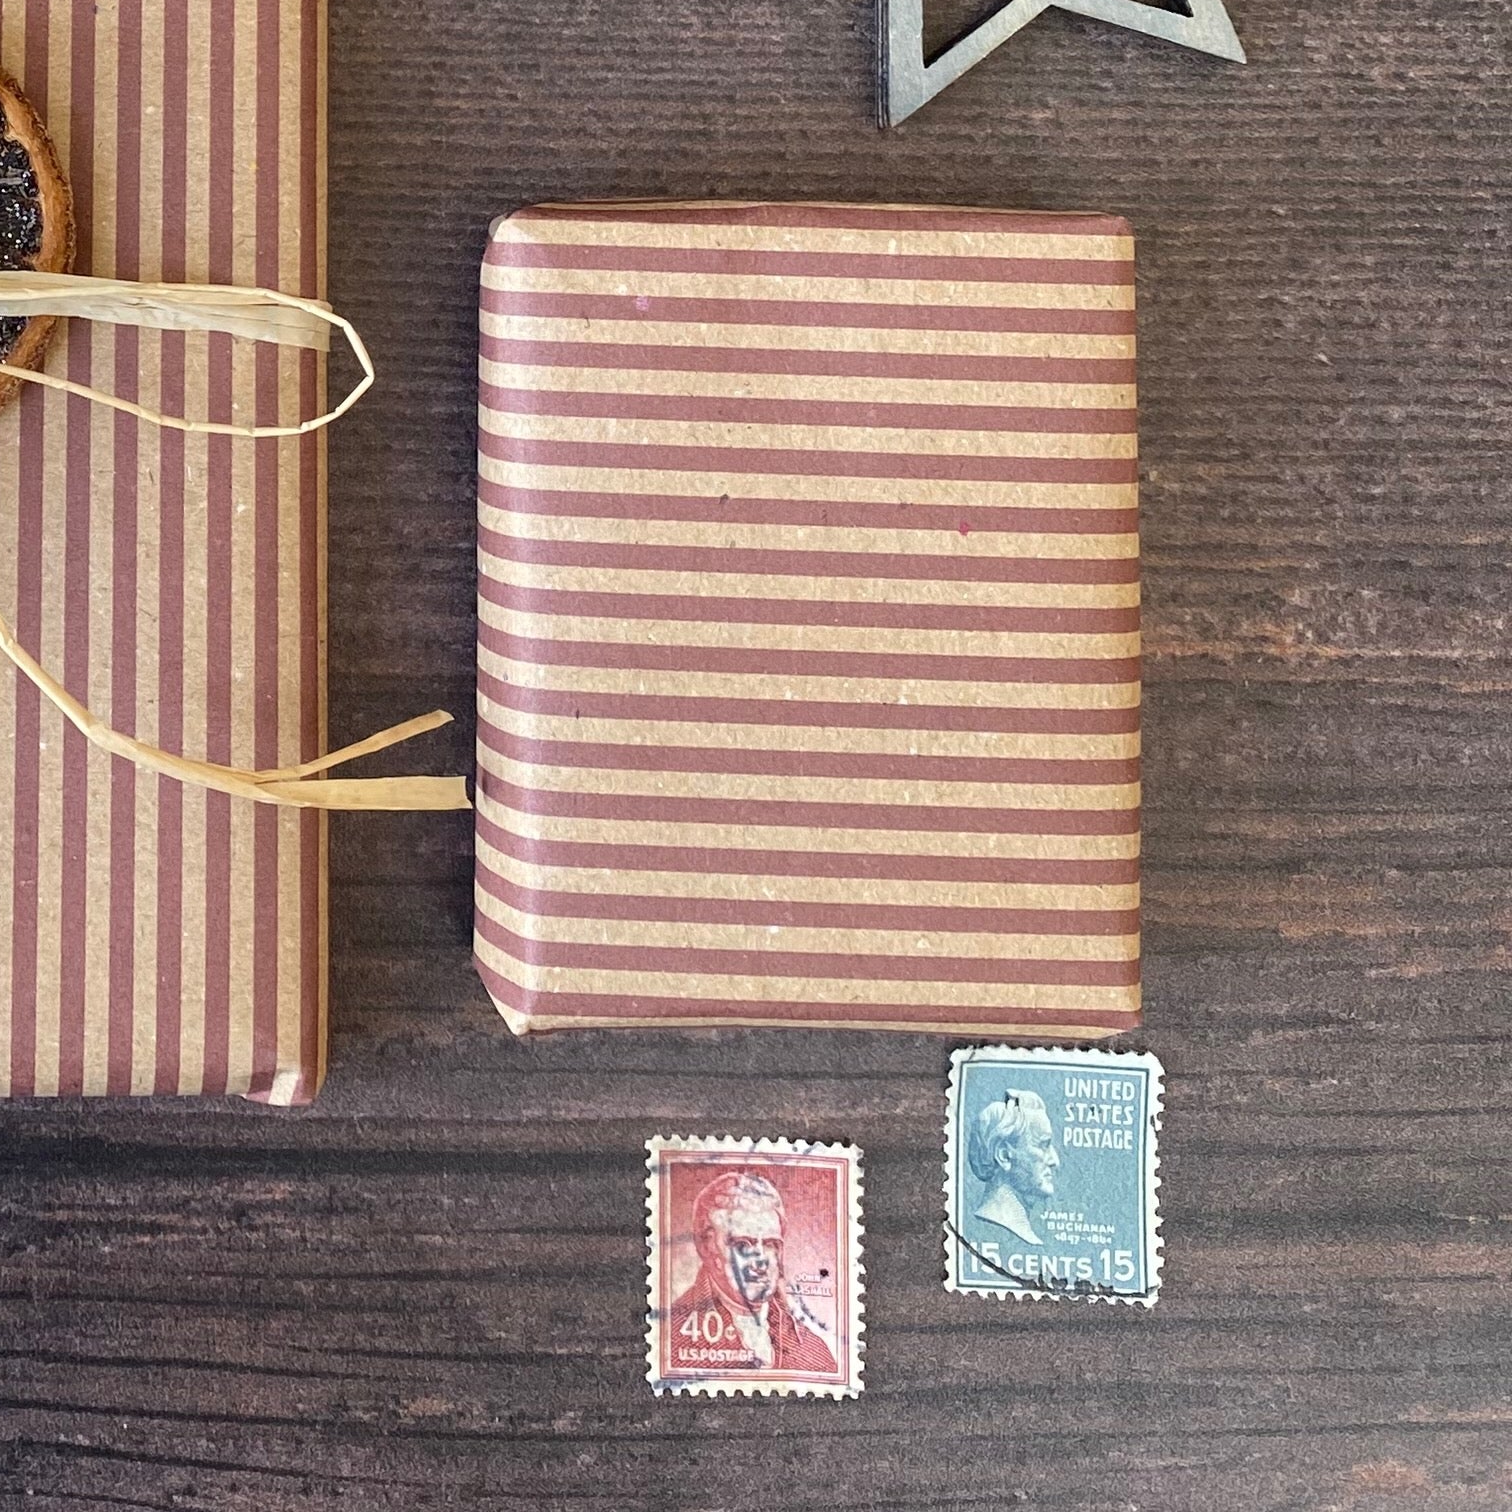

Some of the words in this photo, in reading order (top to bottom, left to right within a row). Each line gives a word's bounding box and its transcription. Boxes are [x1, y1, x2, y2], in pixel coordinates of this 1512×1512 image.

[1064, 1077, 1136, 1102] UNITED
[1064, 1102, 1135, 1126] STATES
[1063, 1126, 1134, 1150] POSTAGE
[1040, 1210, 1084, 1222] JAMES
[1047, 1221, 1116, 1234] BUCHANAN
[1007, 1253, 1094, 1281] CENTS
[1099, 1248, 1135, 1282] 15
